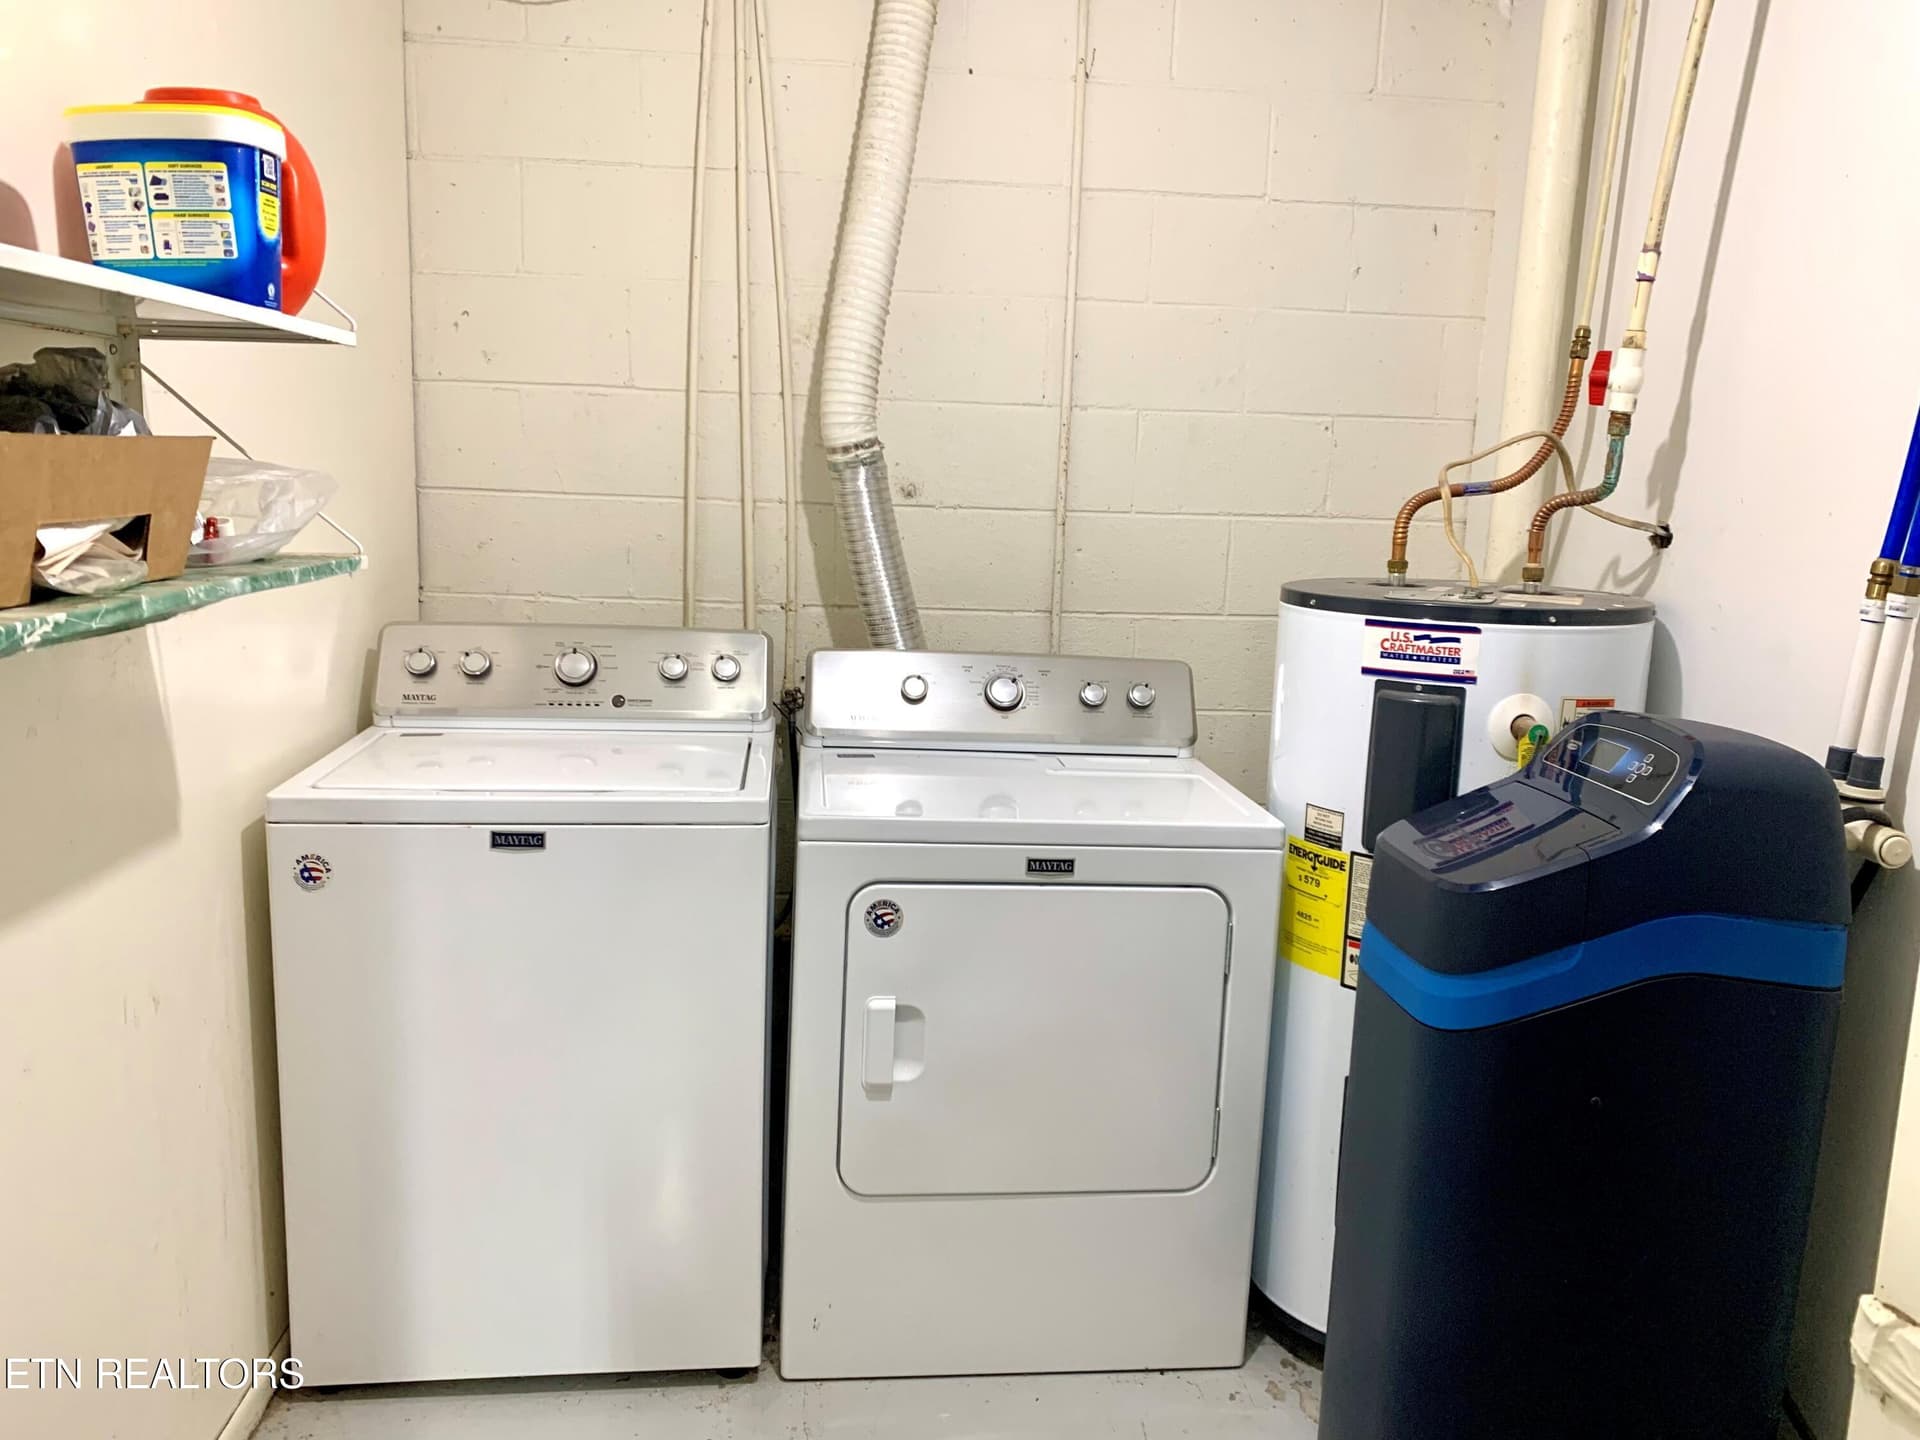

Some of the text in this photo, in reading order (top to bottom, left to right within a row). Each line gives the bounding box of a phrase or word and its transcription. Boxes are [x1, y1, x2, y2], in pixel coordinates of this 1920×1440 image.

[1391, 632, 1412, 643] U.S.
[1380, 638, 1461, 657] CRAFTMASTER
[495, 835, 542, 845] MAYTAG
[296, 854, 331, 873] AMERICA
[1030, 861, 1073, 871] MAYTAG
[867, 901, 899, 916] AMERICA
